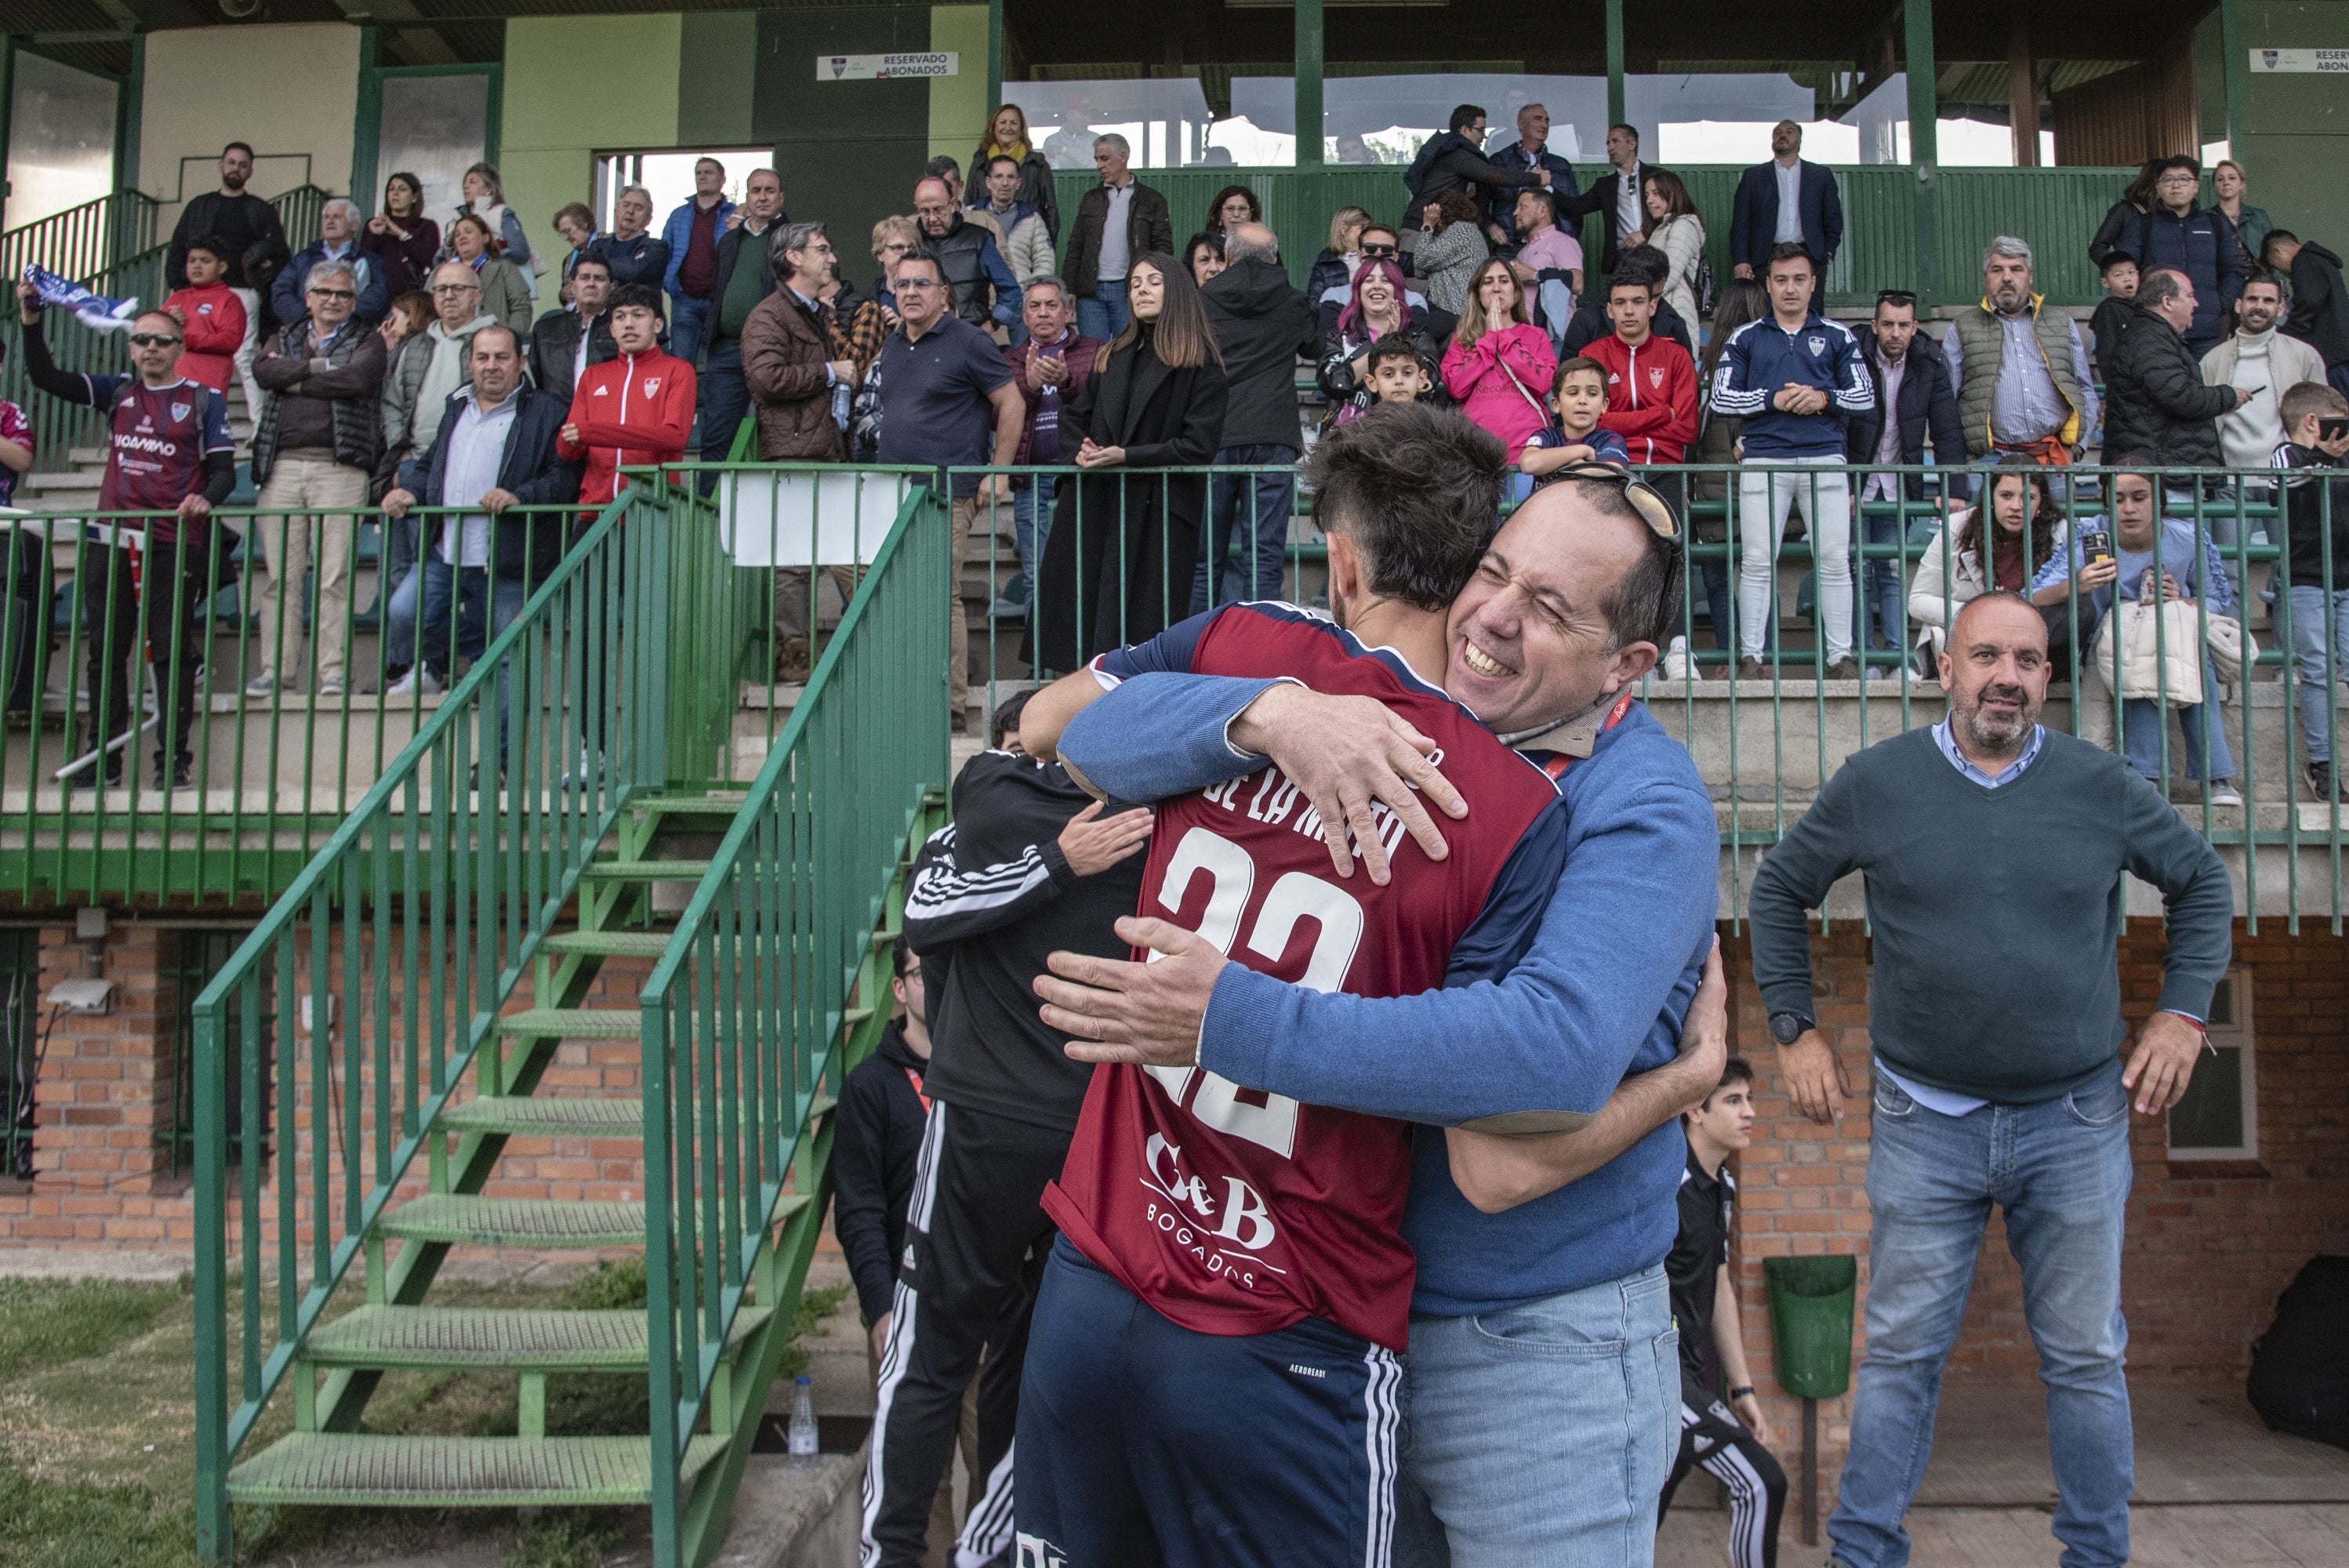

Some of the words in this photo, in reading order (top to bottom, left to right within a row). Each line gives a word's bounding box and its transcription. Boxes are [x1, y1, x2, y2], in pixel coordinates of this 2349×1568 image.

[884, 54, 947, 64] RESERVADO
[884, 65, 947, 76] ABONADOS
[1289, 1363, 1327, 1379] AEROREADY
